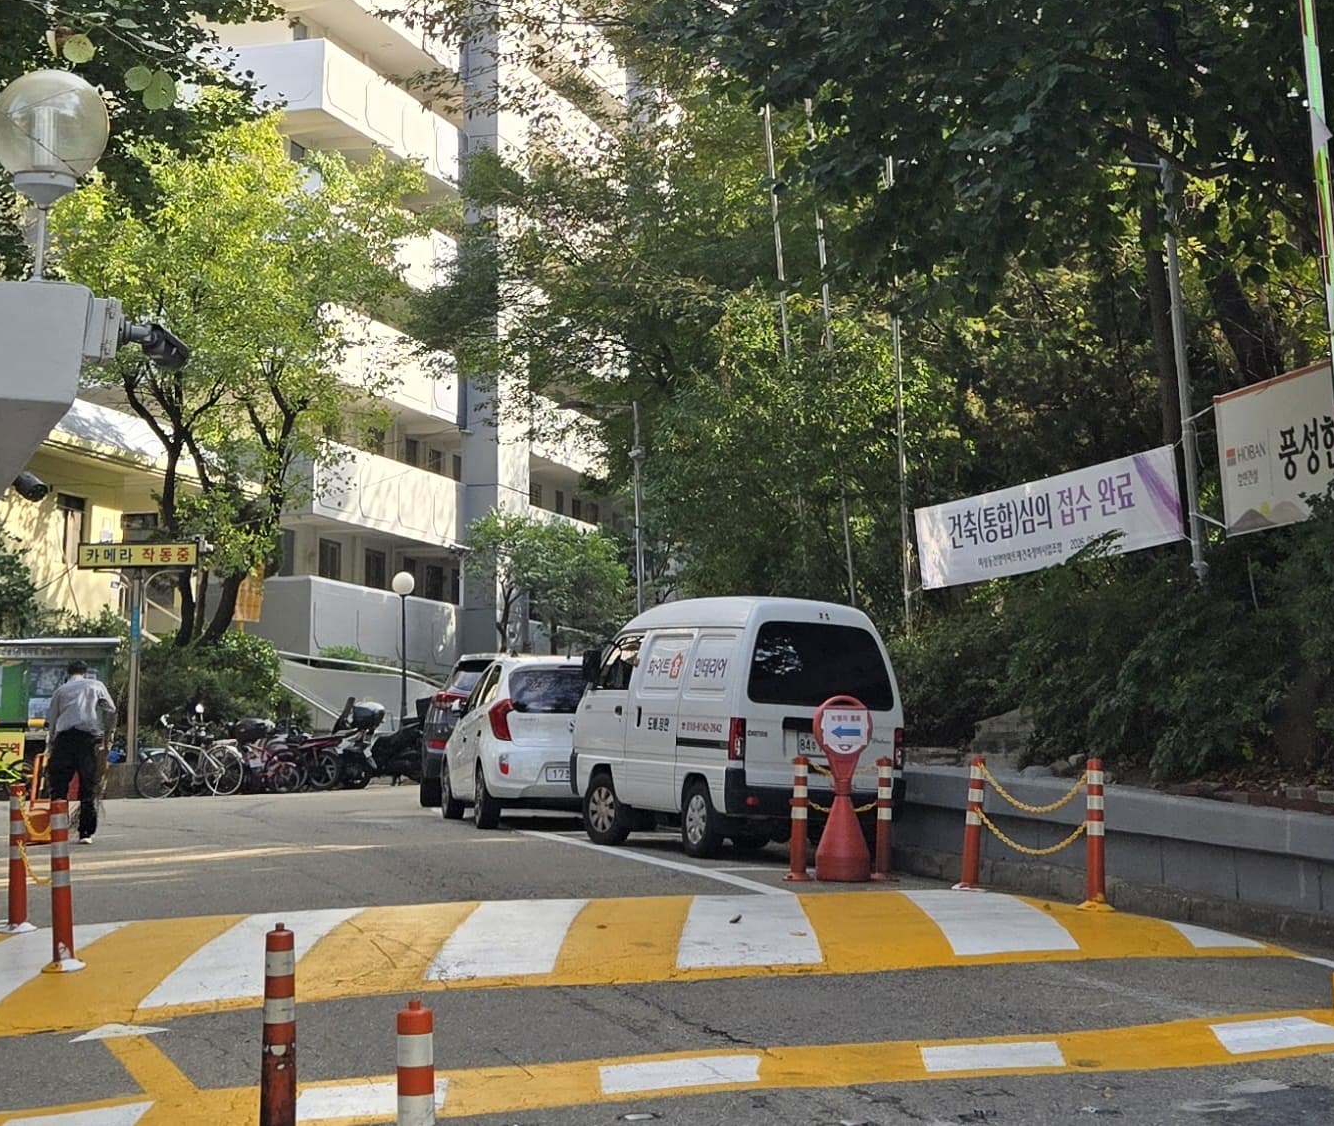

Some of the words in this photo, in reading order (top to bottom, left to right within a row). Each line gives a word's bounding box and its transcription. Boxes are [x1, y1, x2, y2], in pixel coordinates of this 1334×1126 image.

[1237, 441, 1267, 462] HOBAN
[947, 492, 1053, 551] 건축(통합)심의
[1056, 483, 1093, 527] 접수
[1097, 472, 1137, 517] 완료
[86, 547, 133, 563] 카메라
[141, 547, 190, 563] 작동중
